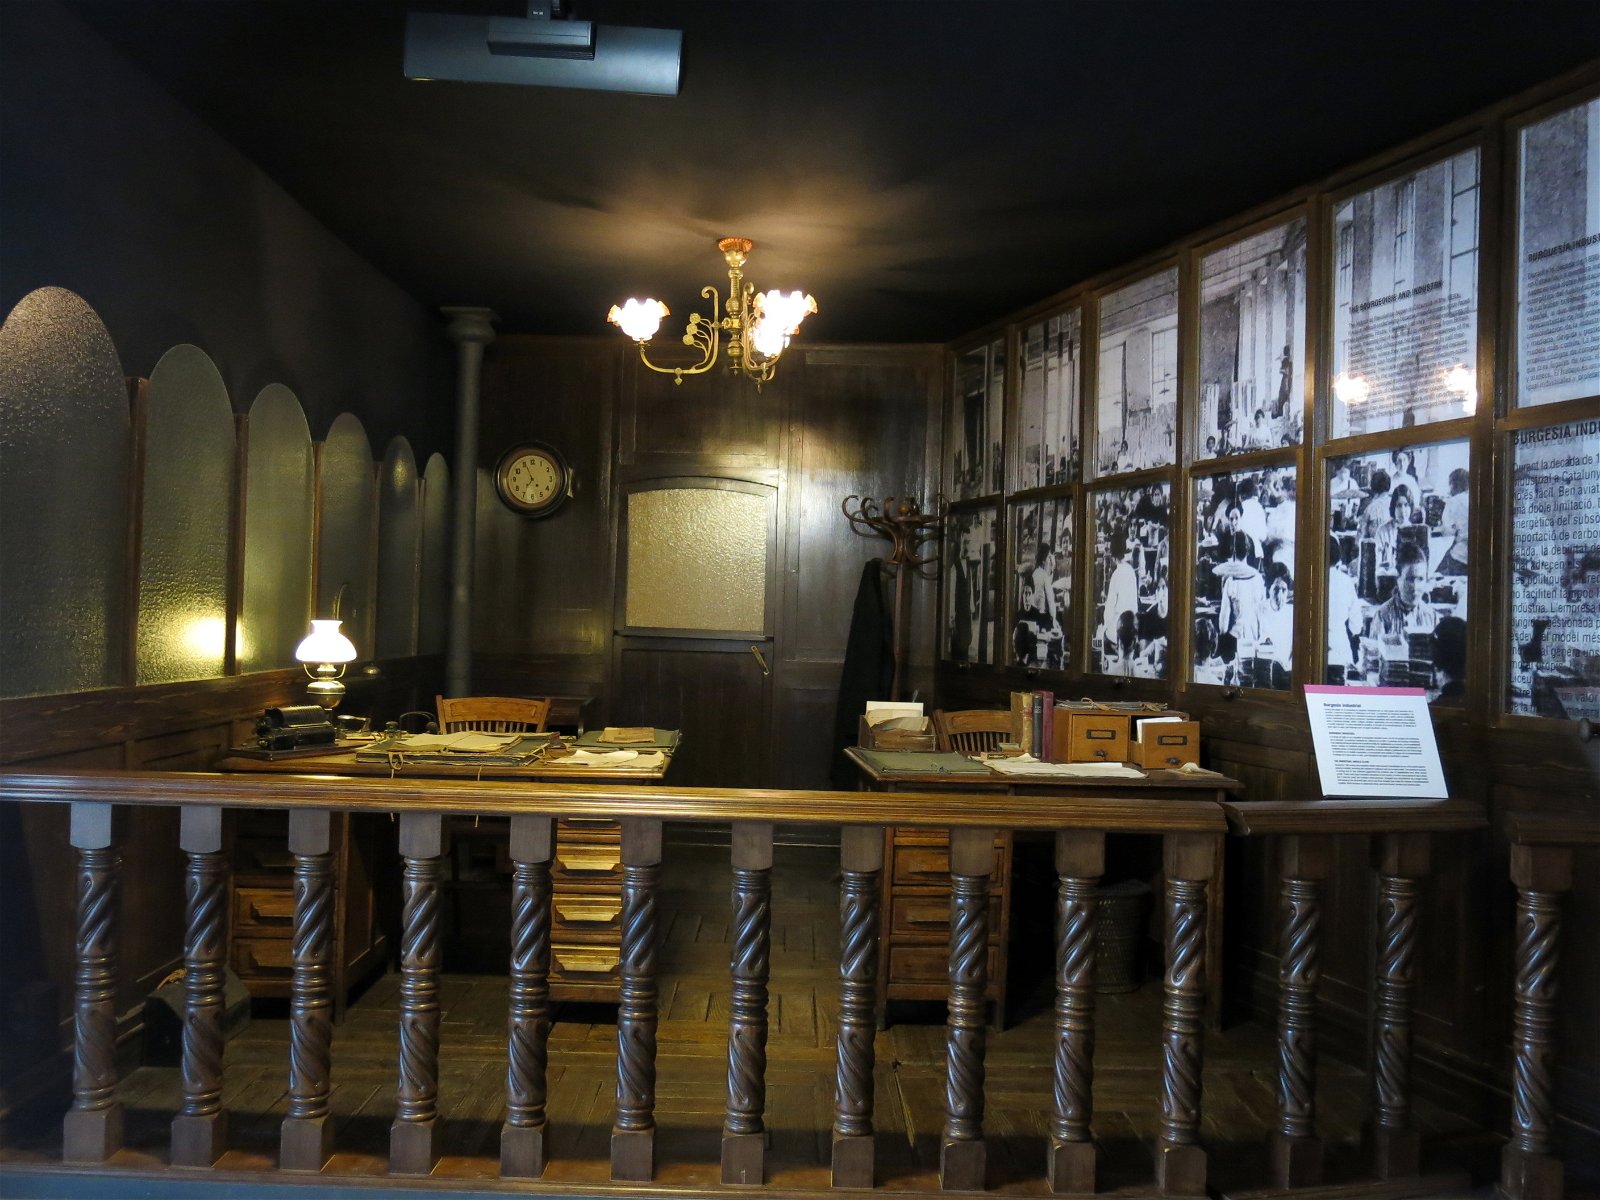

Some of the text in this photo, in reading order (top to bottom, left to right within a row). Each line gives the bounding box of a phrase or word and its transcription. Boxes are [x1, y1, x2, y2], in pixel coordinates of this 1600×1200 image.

[1575, 420, 1600, 437] IND
[1583, 453, 1594, 466] de
[1514, 473, 1553, 487] ndustrial
[1558, 485, 1576, 498] Ben
[1528, 502, 1552, 514] doble
[1513, 529, 1557, 546] mportació
[1559, 529, 1570, 541] de
[1541, 544, 1549, 556] la
[1512, 601, 1548, 613] ndústria.
